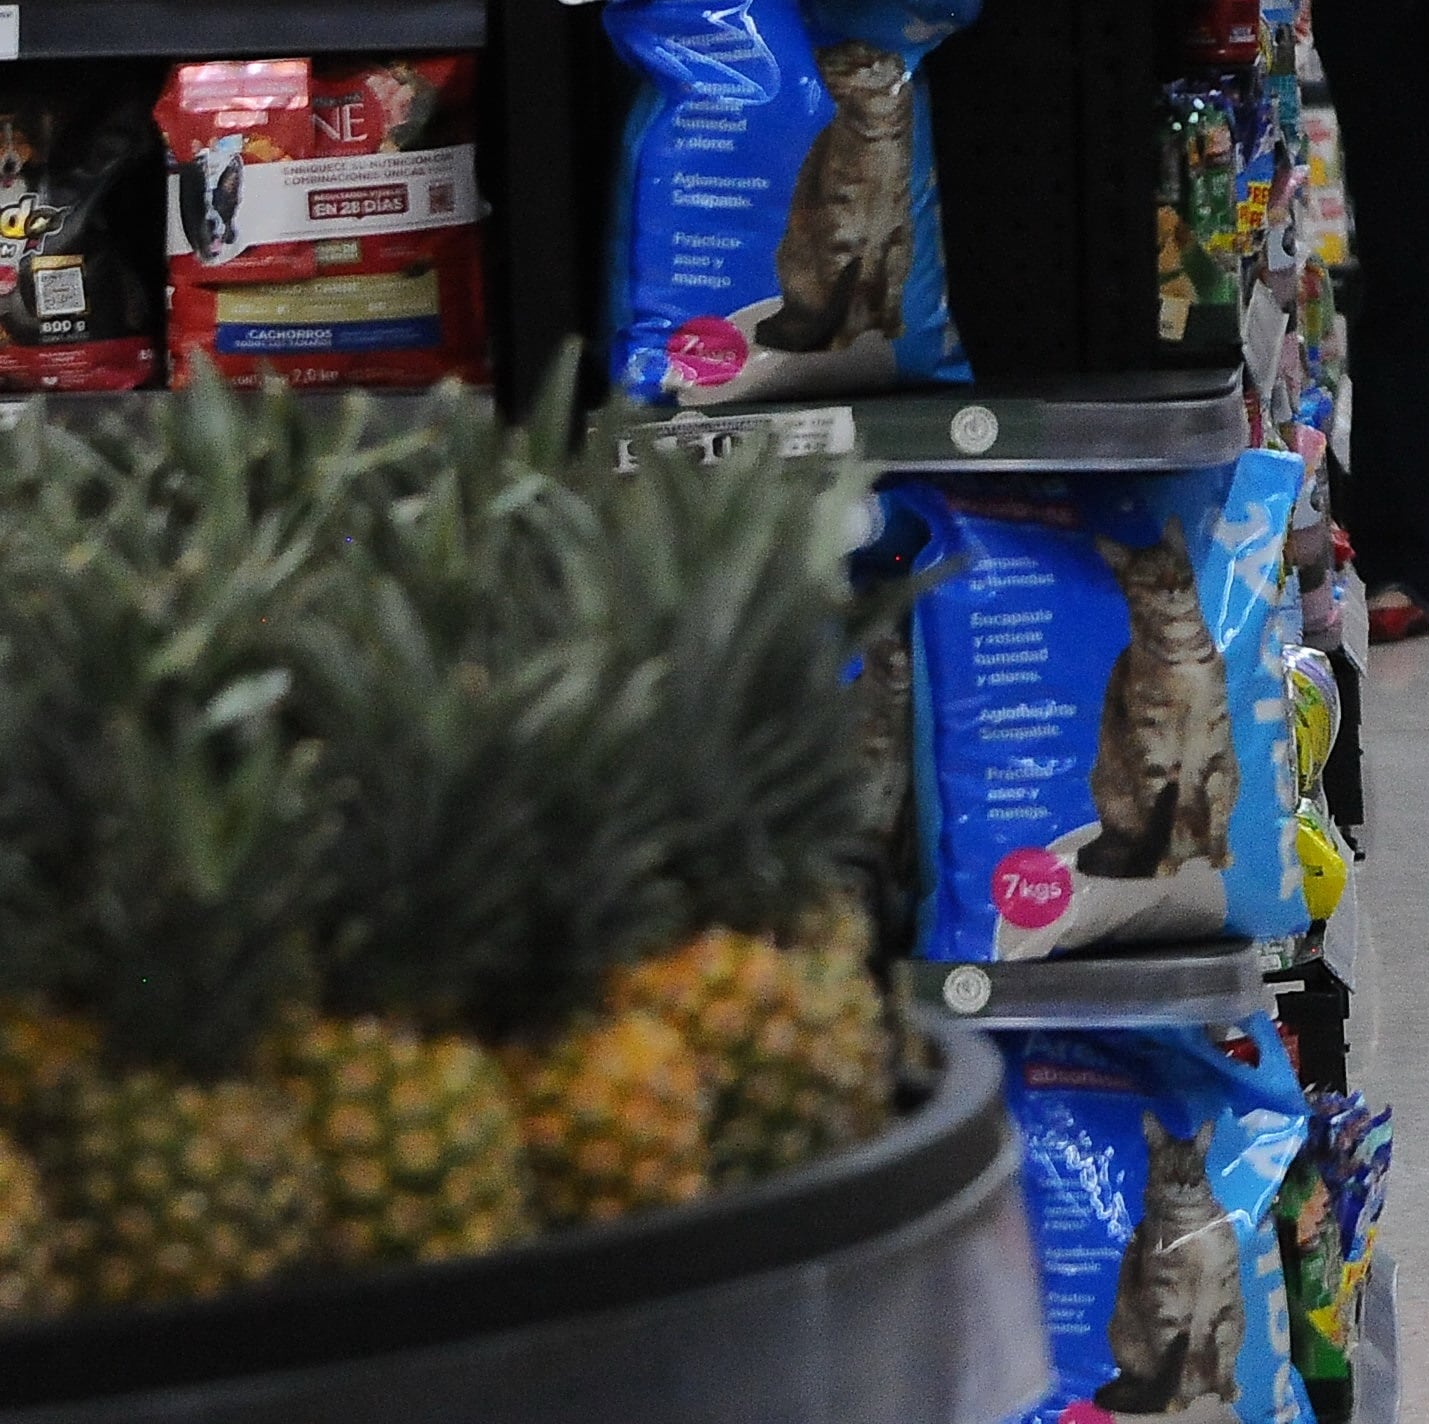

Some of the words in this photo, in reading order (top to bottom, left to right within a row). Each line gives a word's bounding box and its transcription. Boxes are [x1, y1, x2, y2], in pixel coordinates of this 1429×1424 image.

[311, 102, 368, 142] NE
[247, 328, 333, 340] CACHORROS
[971, 609, 1053, 628] Encapsula
[974, 647, 1049, 666] humedad
[1003, 872, 1063, 905] 7kgs
